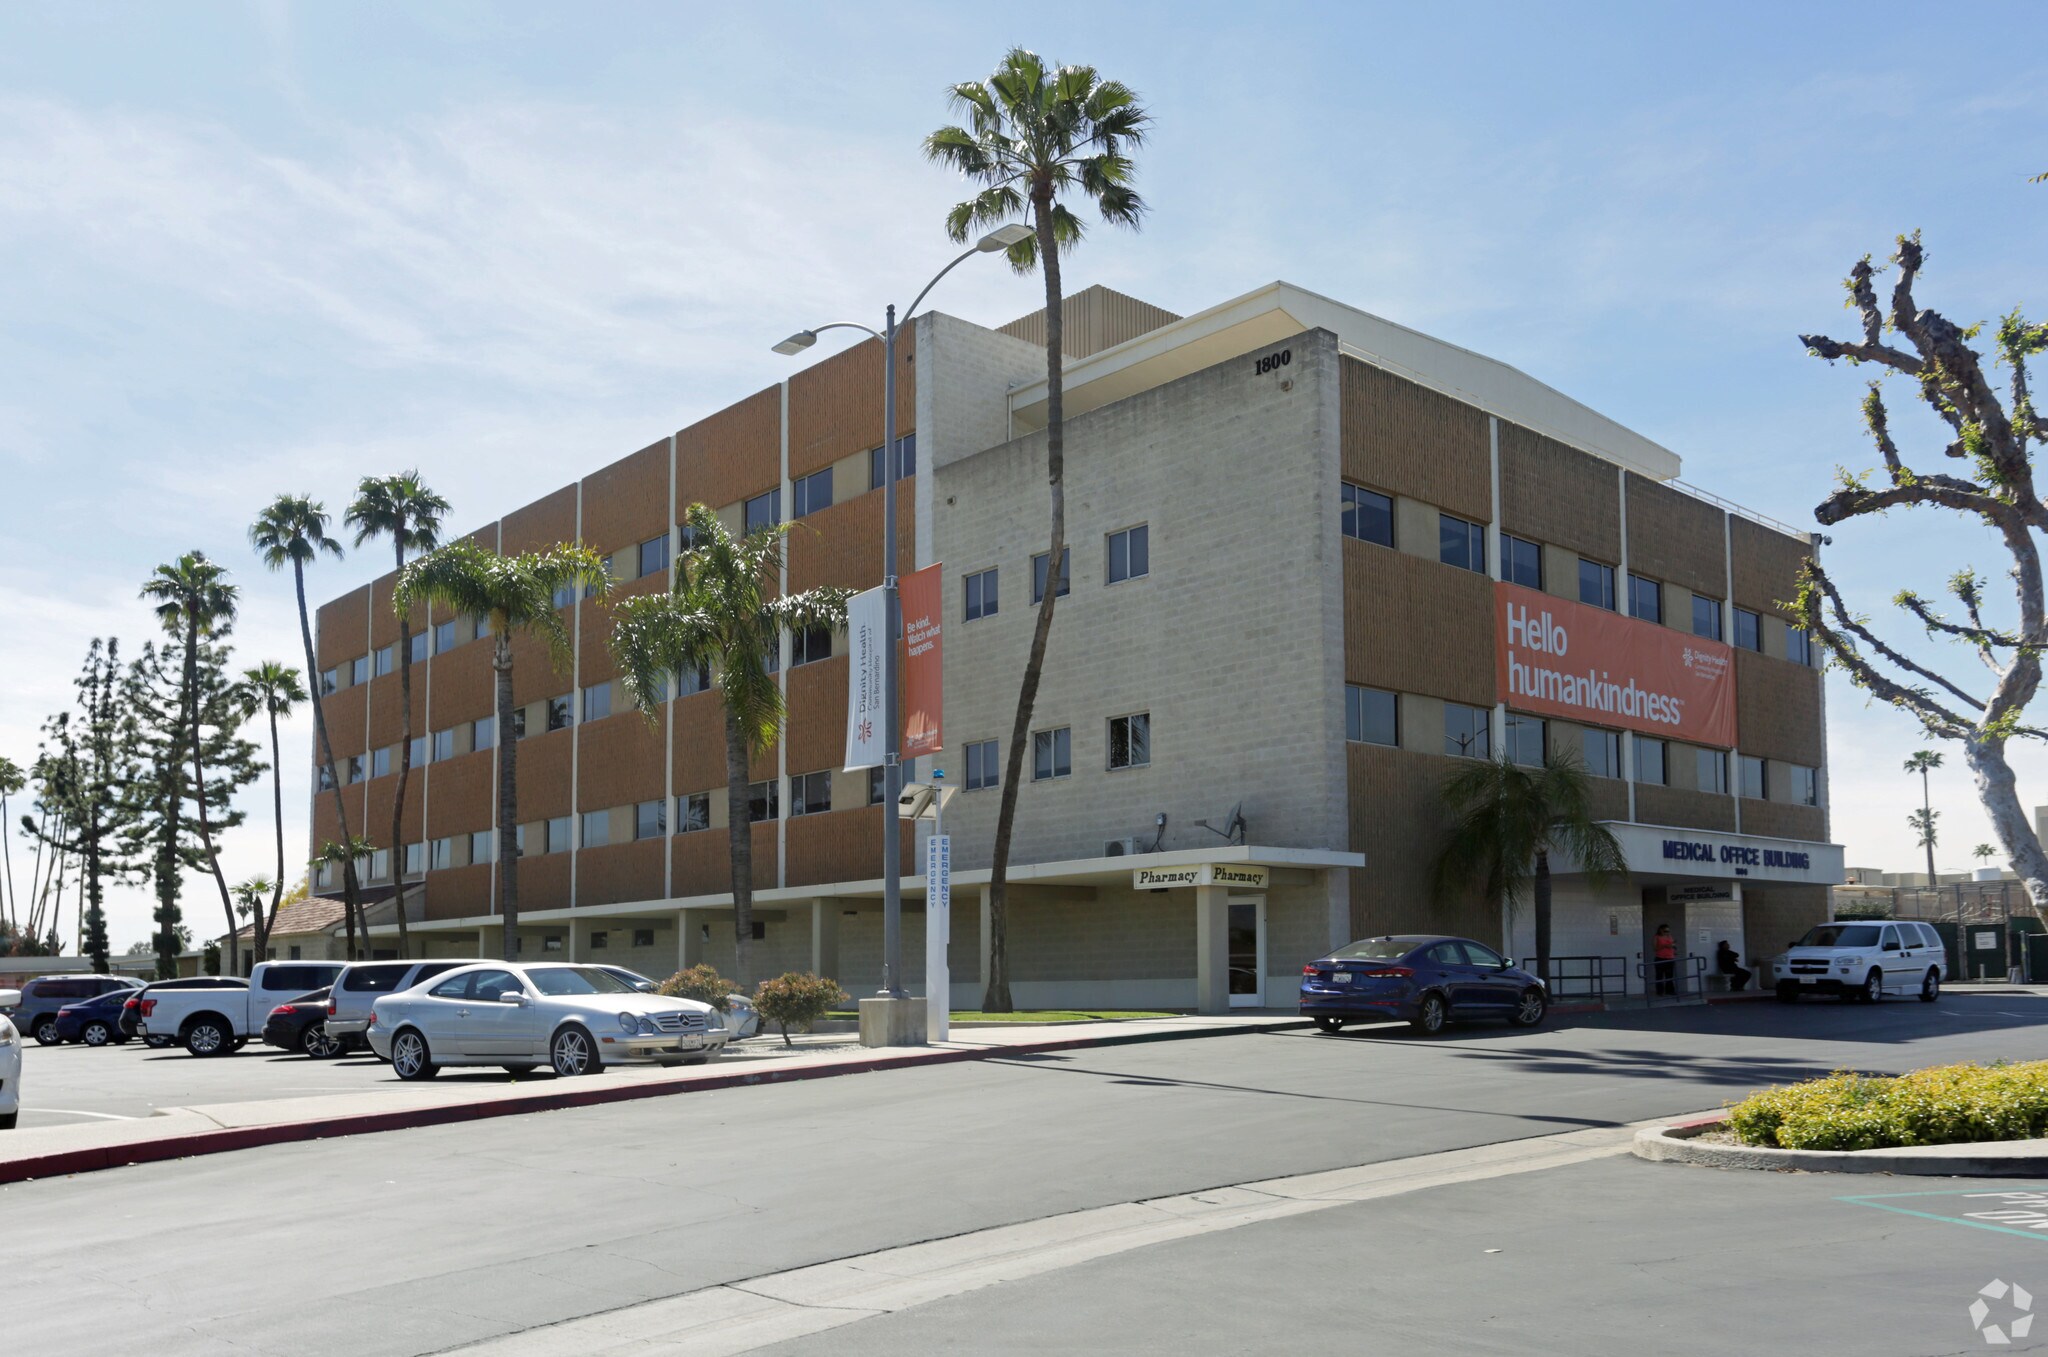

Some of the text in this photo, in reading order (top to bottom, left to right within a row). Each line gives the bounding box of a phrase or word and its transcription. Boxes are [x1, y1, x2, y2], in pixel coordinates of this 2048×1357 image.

[1256, 349, 1291, 376] 1800
[907, 622, 916, 634] Be
[908, 623, 941, 645] Watch what
[1507, 602, 1568, 657] Hello
[908, 640, 935, 657] happens.
[859, 624, 868, 713] Dignity Health
[1662, 840, 1810, 870] MEDICAL OFFICE BUILDING
[941, 838, 949, 909] EMERGENCY
[1139, 871, 1198, 884] Pharmacy
[1213, 867, 1264, 885] Pharmacy
